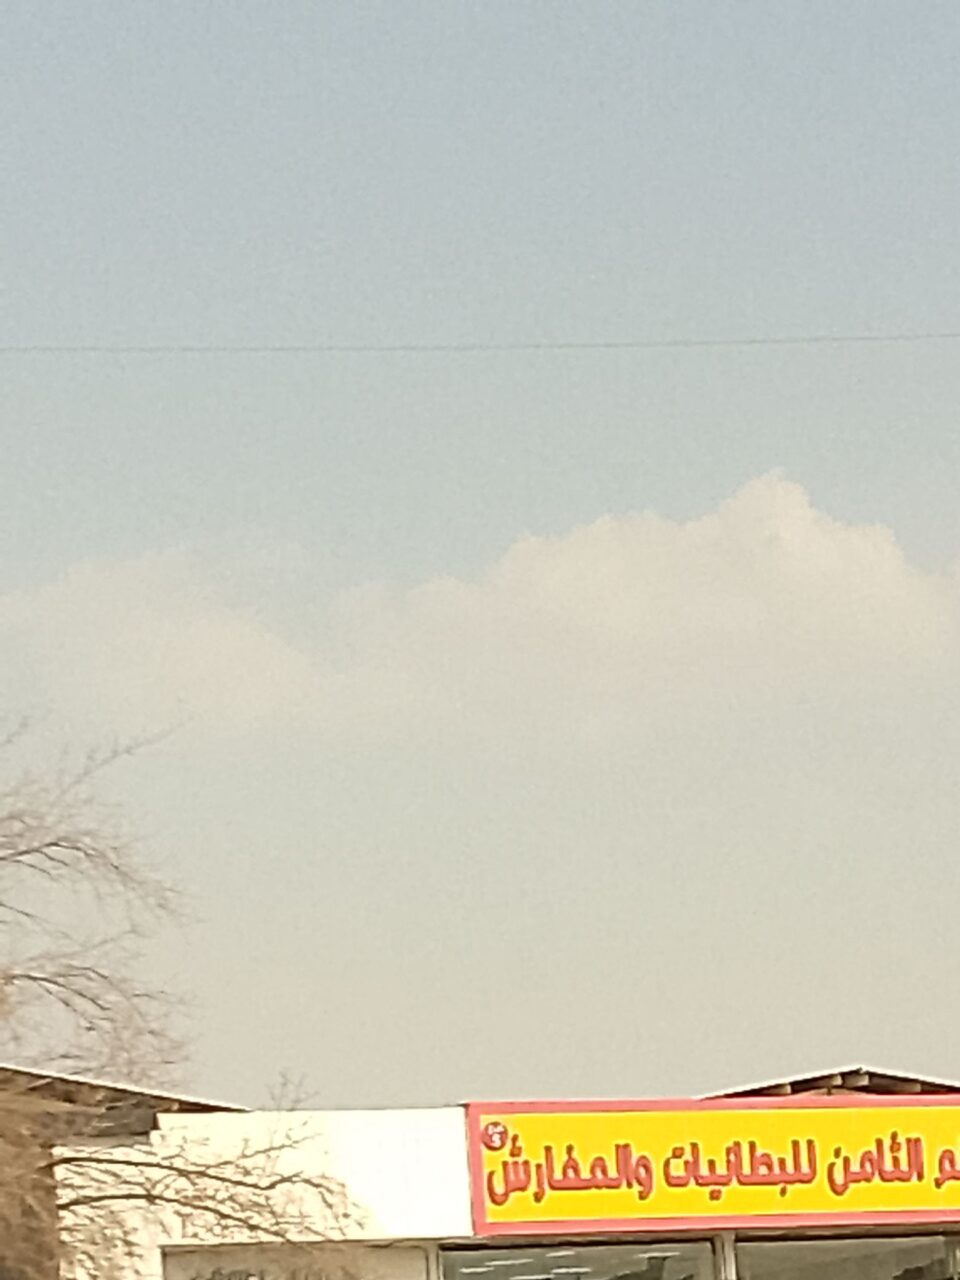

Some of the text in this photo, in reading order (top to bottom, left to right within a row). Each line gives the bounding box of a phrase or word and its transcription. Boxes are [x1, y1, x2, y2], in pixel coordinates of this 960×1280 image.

[487, 1134, 653, 1206] والمفارش
[663, 1139, 816, 1201] للبطانيات
[827, 1131, 923, 1195] الثامن
